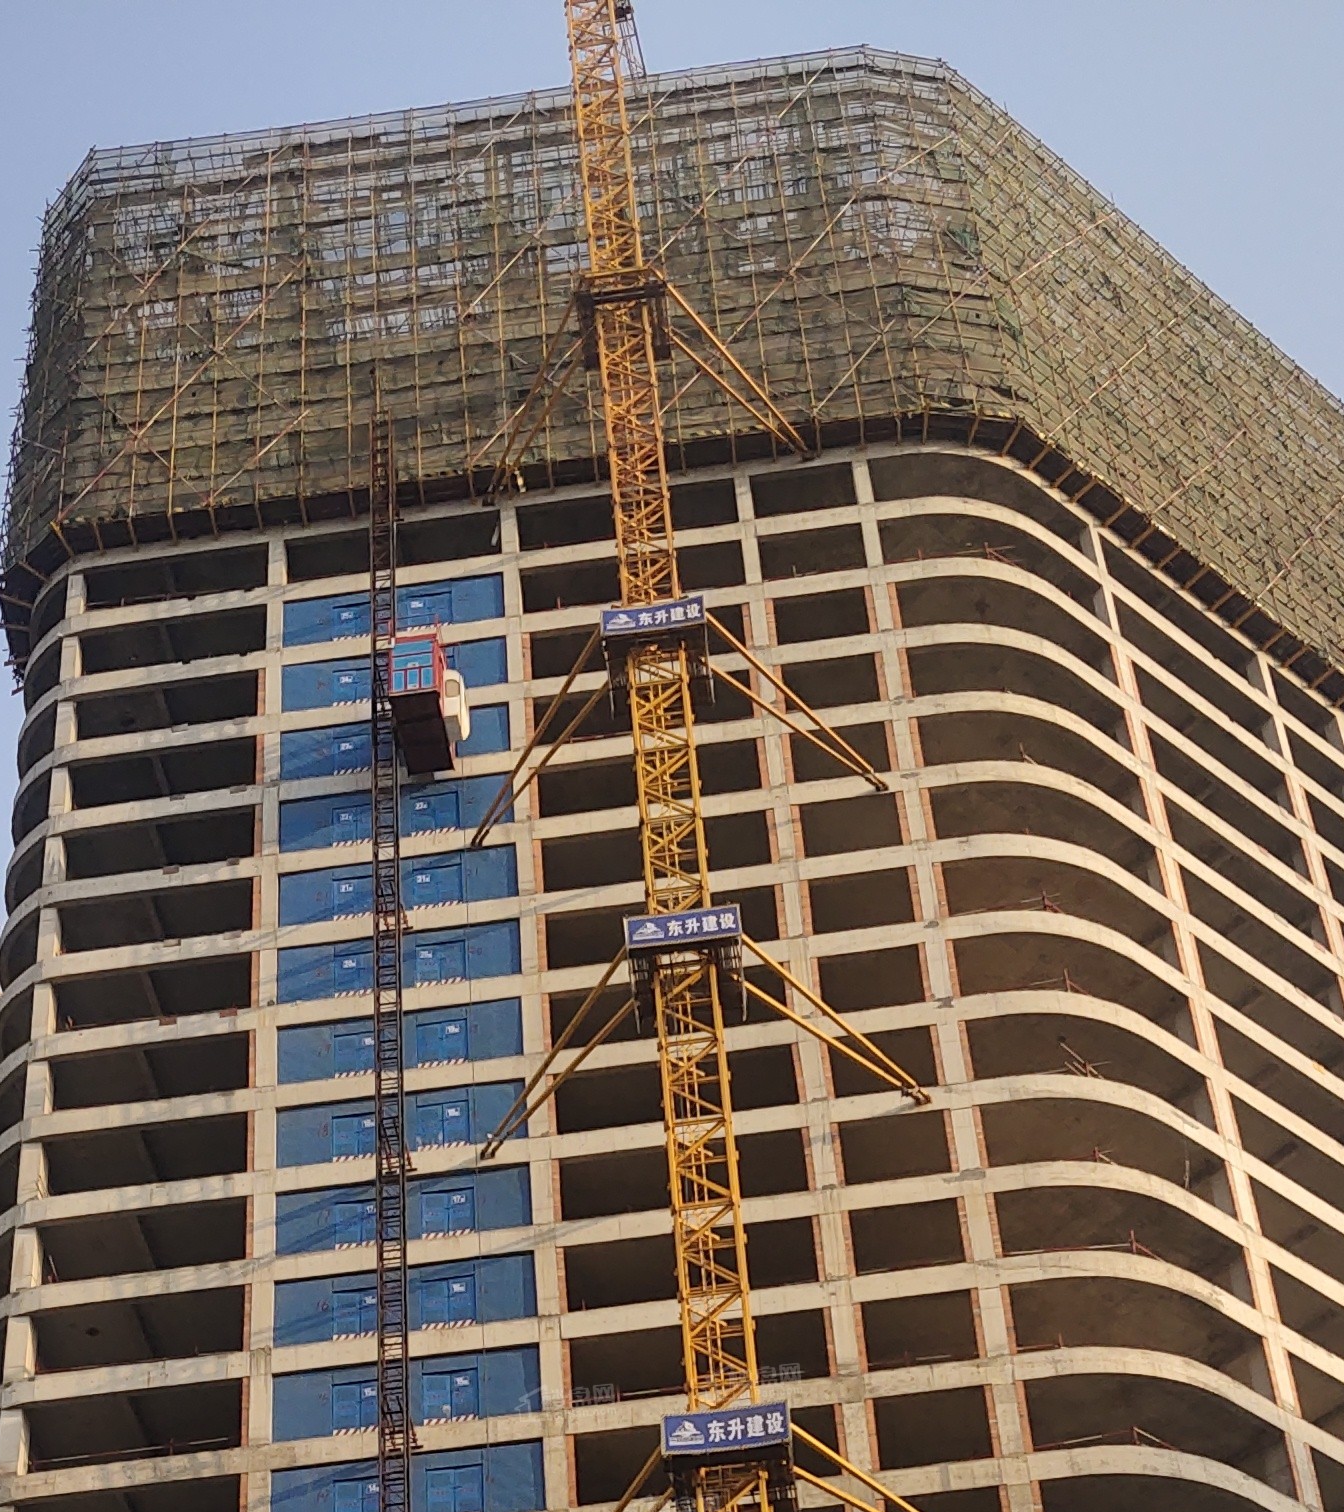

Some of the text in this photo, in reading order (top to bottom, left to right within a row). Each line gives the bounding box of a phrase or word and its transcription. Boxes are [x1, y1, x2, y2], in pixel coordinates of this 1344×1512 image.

[638, 603, 702, 626] 东升建设
[666, 912, 737, 937] 东升建设
[707, 1412, 785, 1443] 东升建设
